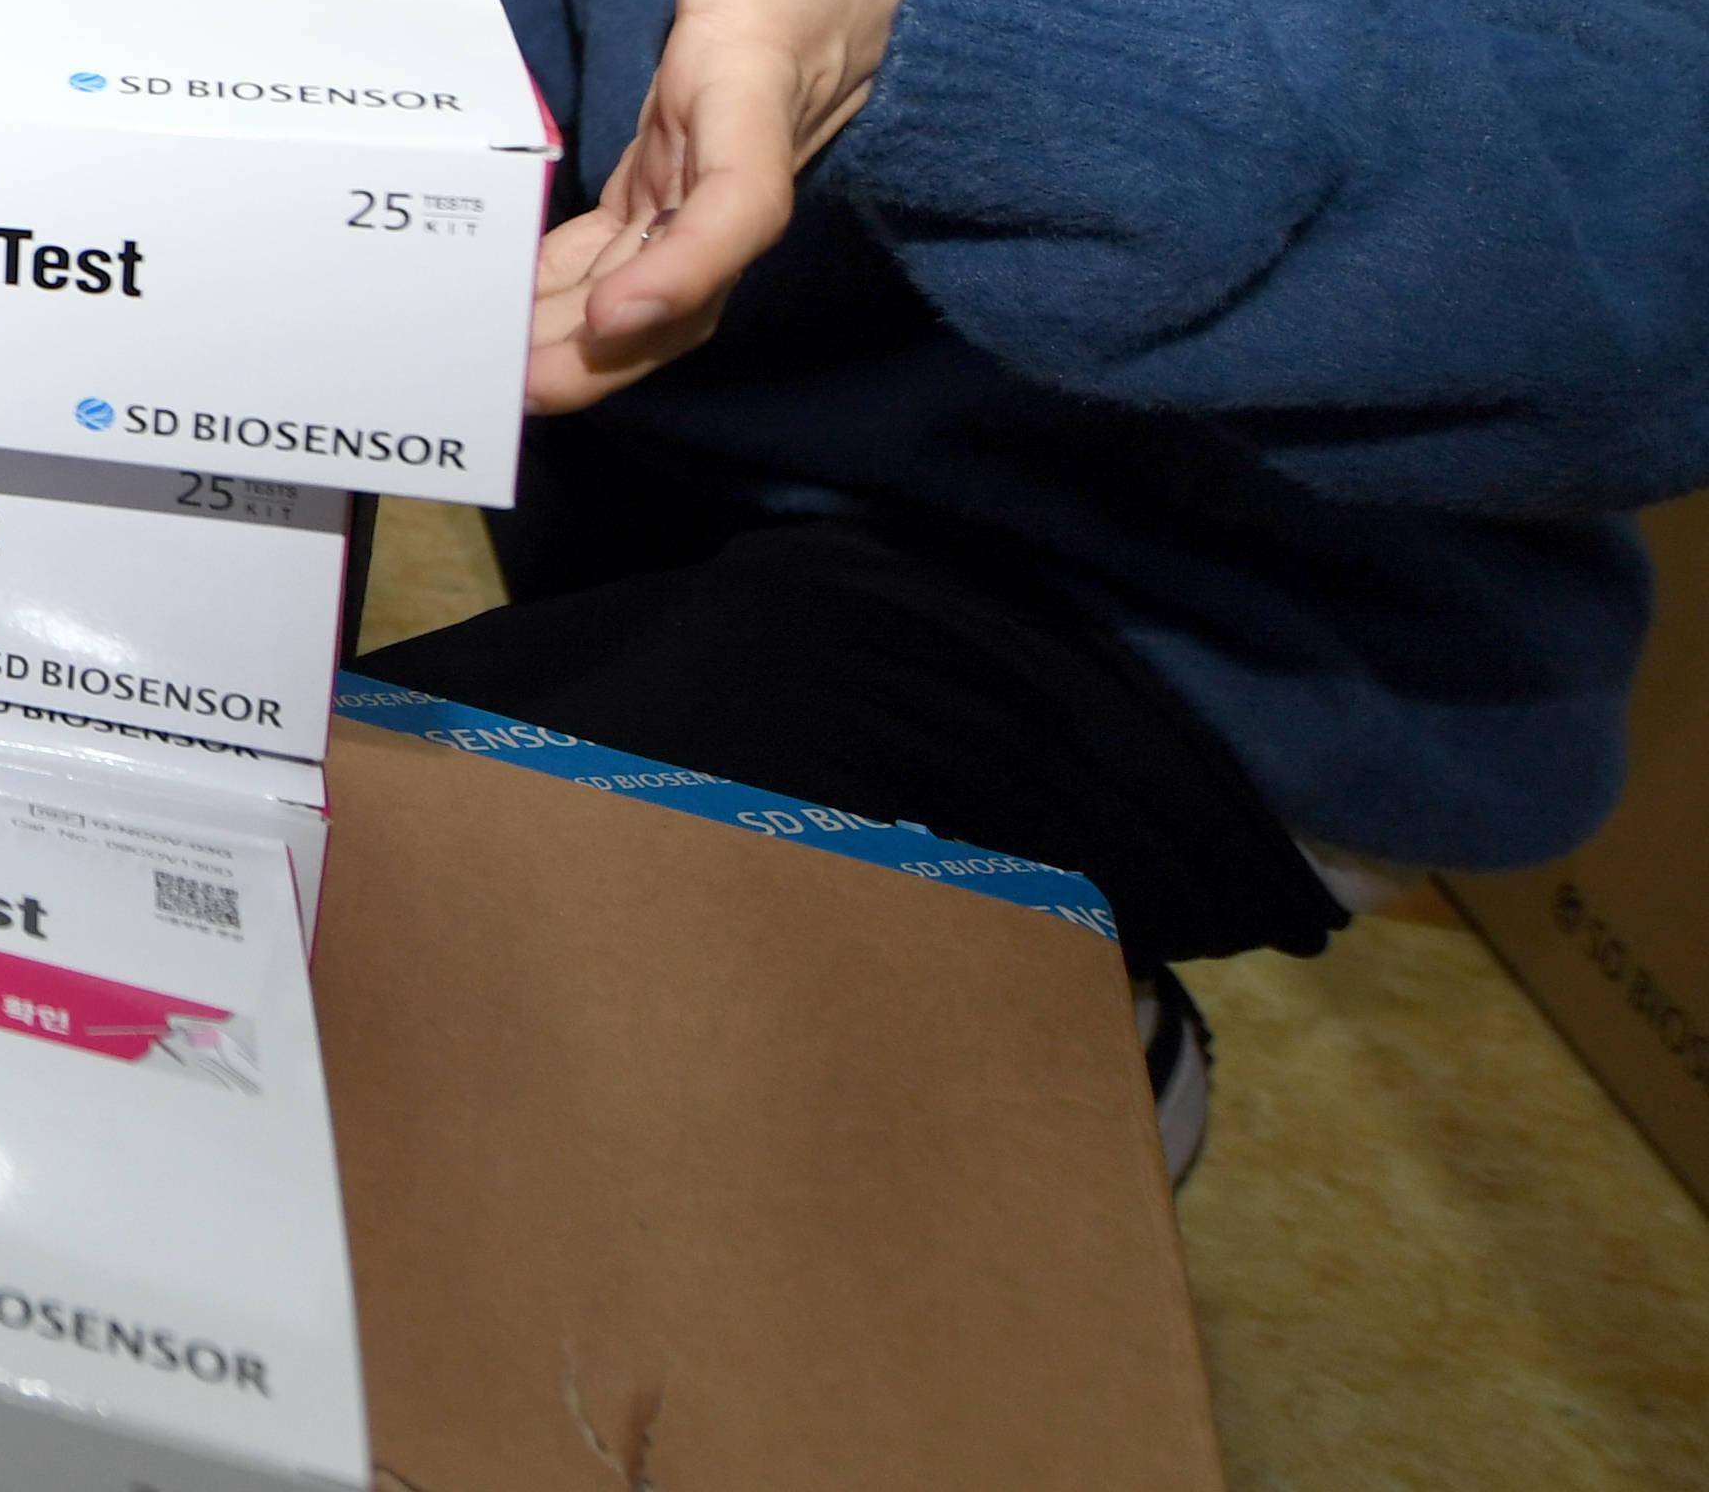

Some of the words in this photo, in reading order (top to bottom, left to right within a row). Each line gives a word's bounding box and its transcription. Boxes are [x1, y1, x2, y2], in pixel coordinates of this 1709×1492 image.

[118, 74, 173, 96] SD
[189, 78, 465, 112] BIOSENSOR
[346, 190, 414, 232] 25
[124, 405, 180, 437] SD
[193, 412, 467, 471] BIOSENSOR
[41, 661, 284, 729] BIOSENSOR
